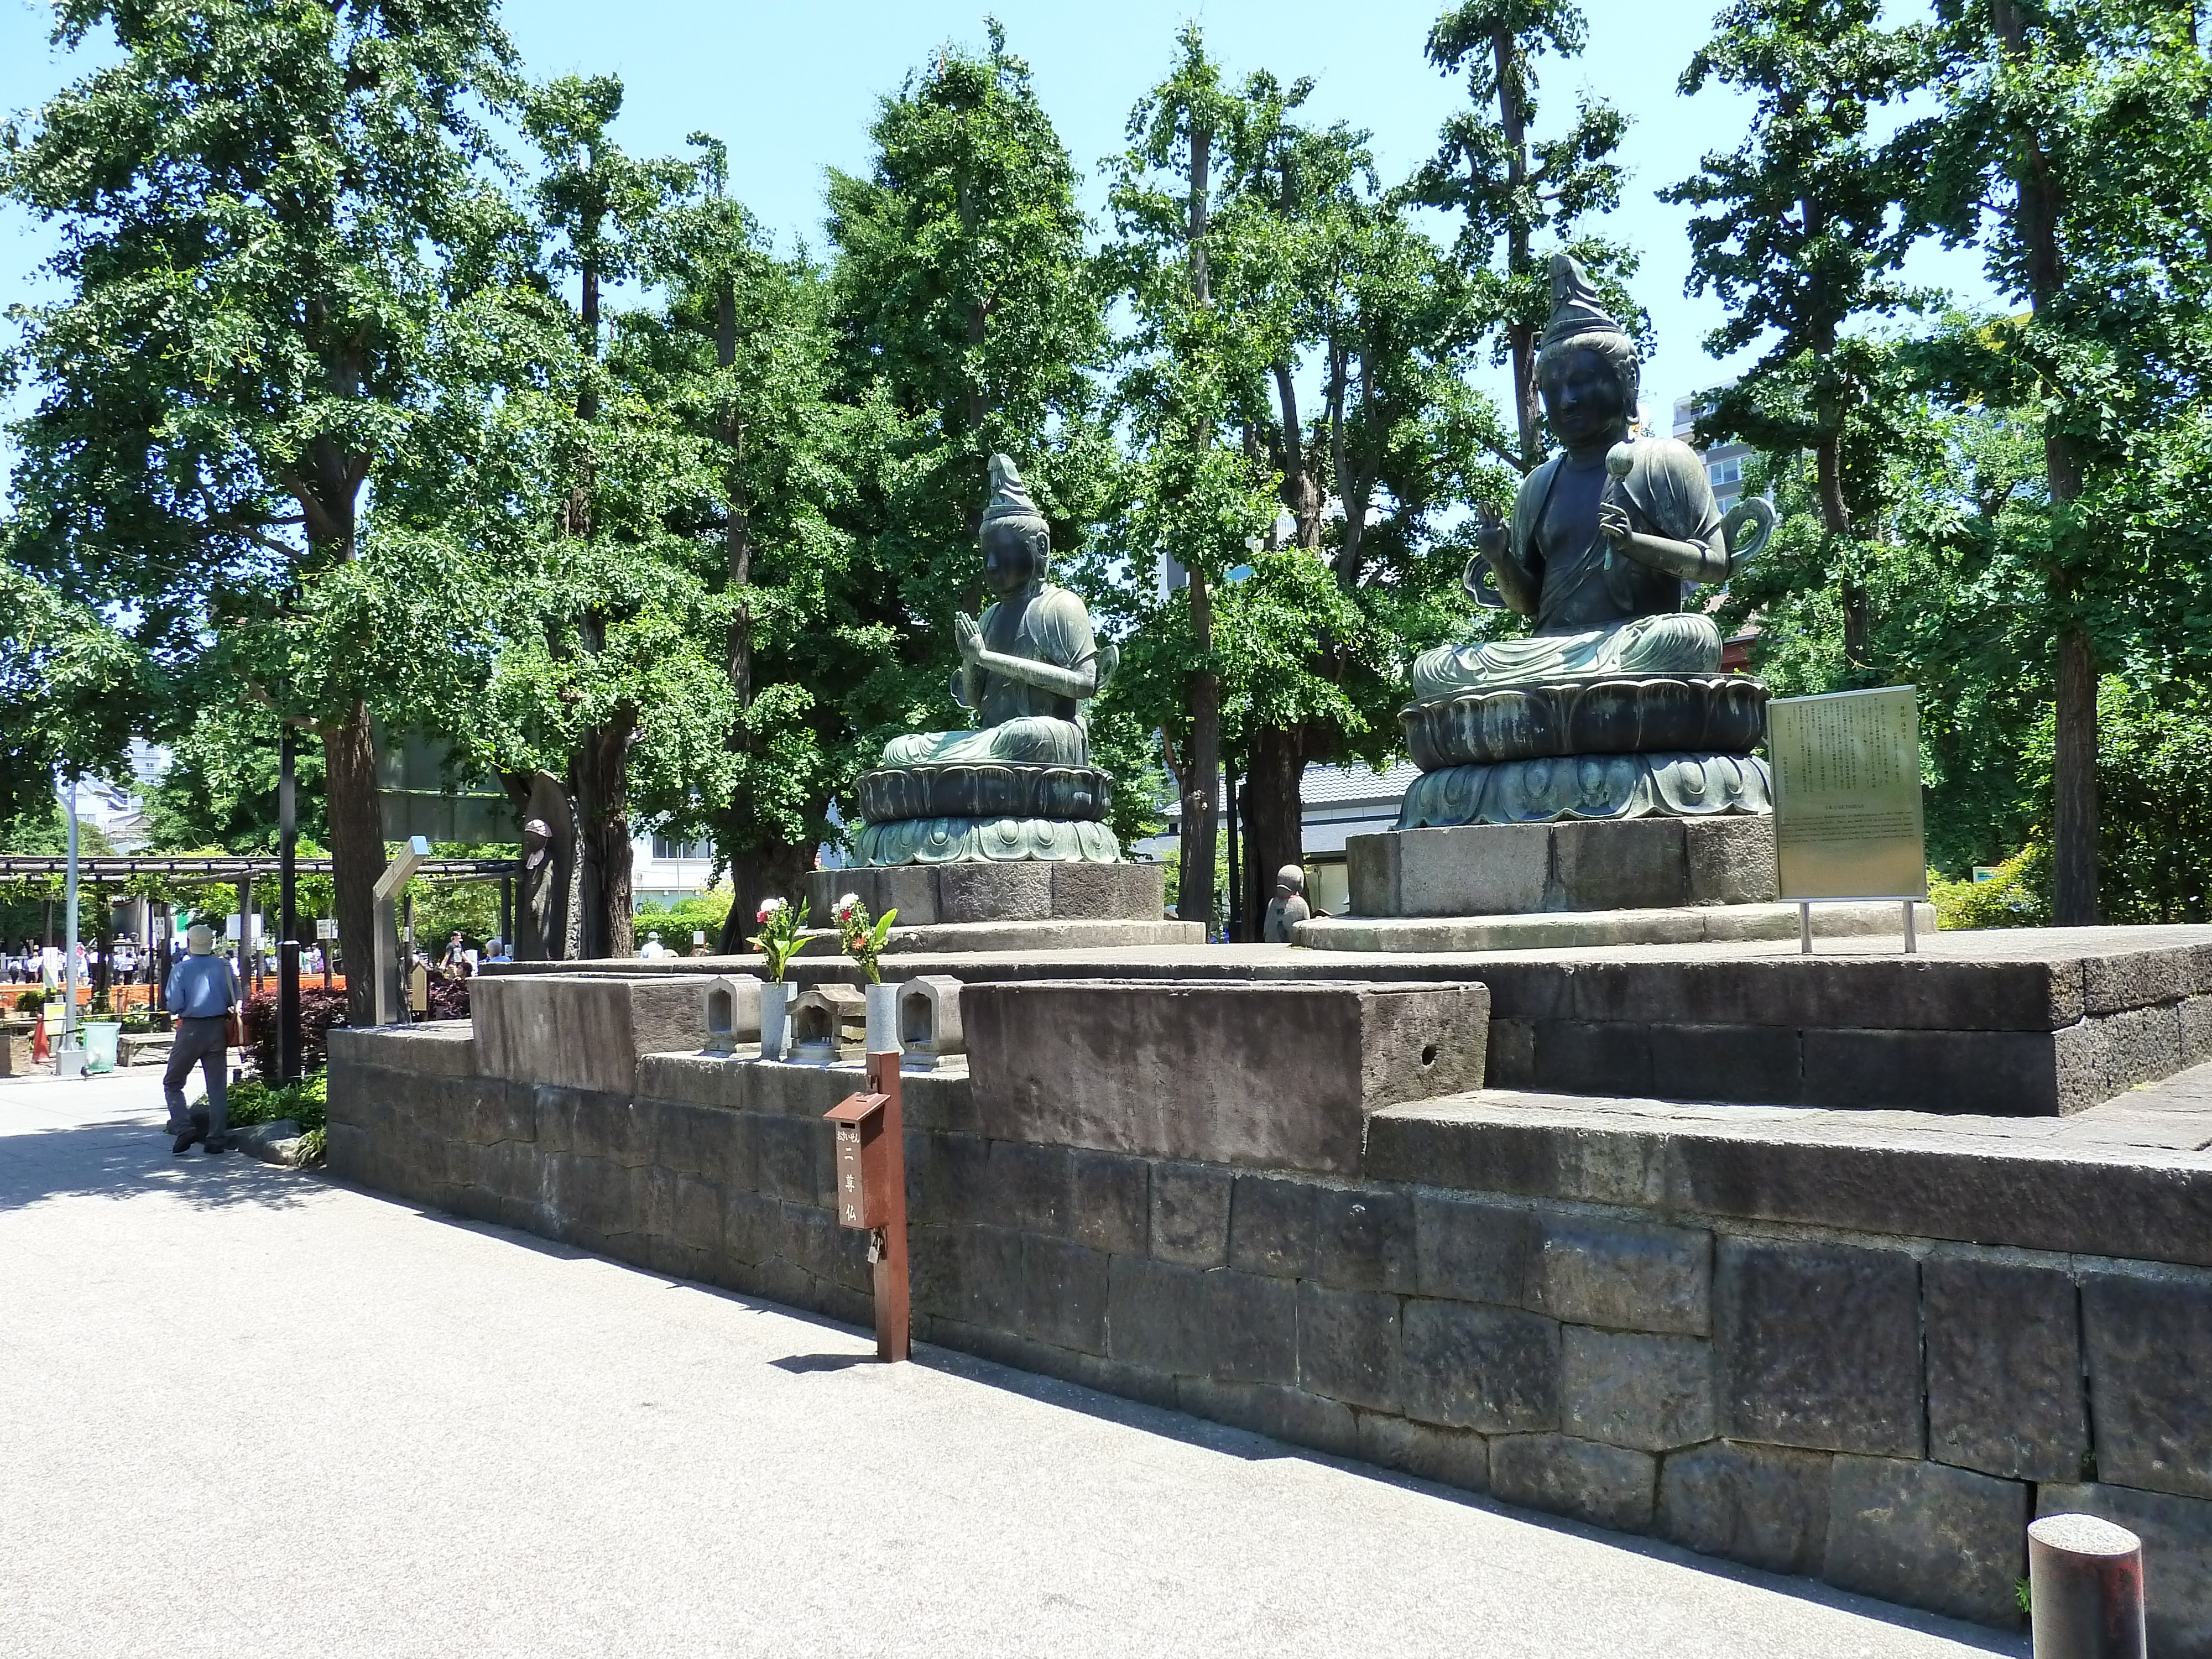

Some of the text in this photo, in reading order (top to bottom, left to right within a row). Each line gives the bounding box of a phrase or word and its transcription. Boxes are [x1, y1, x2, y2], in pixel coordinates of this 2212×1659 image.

[837, 1130, 860, 1144] おさいせん
[844, 1147, 857, 1222] 二尊仏
